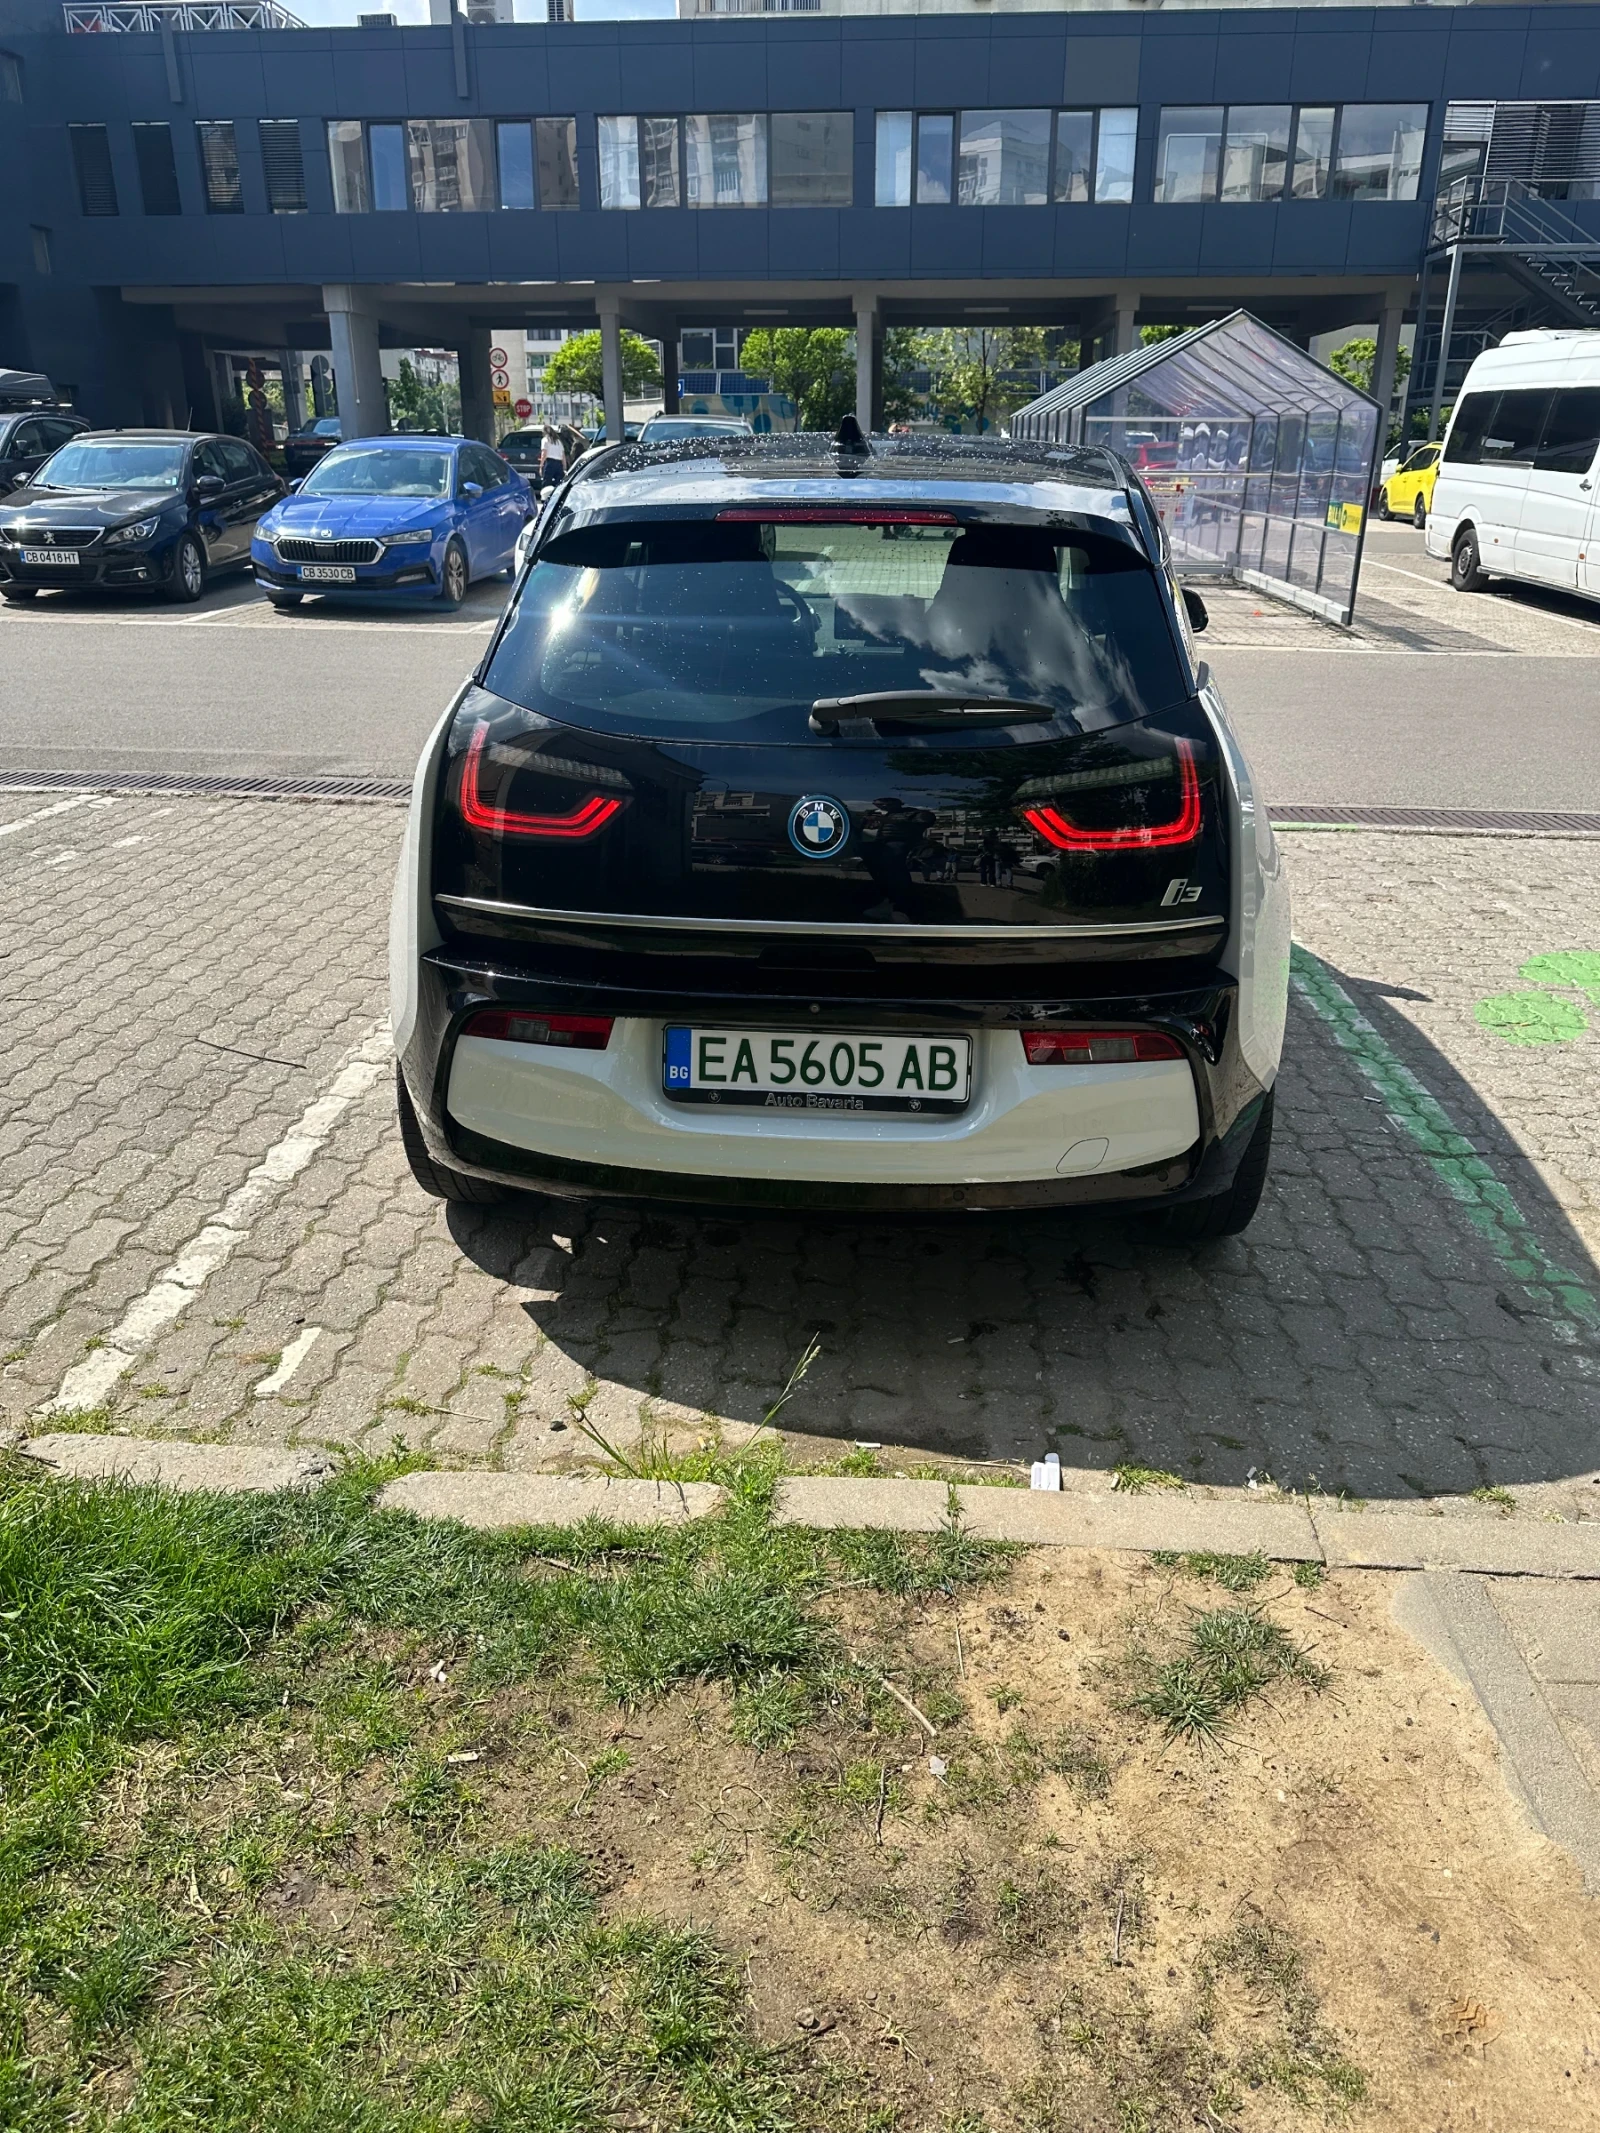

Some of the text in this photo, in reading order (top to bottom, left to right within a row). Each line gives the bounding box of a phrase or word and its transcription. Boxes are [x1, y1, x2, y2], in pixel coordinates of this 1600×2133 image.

[516, 404, 531, 413] STOP
[25, 552, 77, 563] CB 0418 HT
[302, 567, 354, 579] CB 3530 CB
[799, 802, 840, 820] BMW
[1160, 878, 1203, 906] i3
[669, 1036, 958, 1091] BG EA 5605 AB
[764, 1092, 864, 1110] Auto Bavaria
